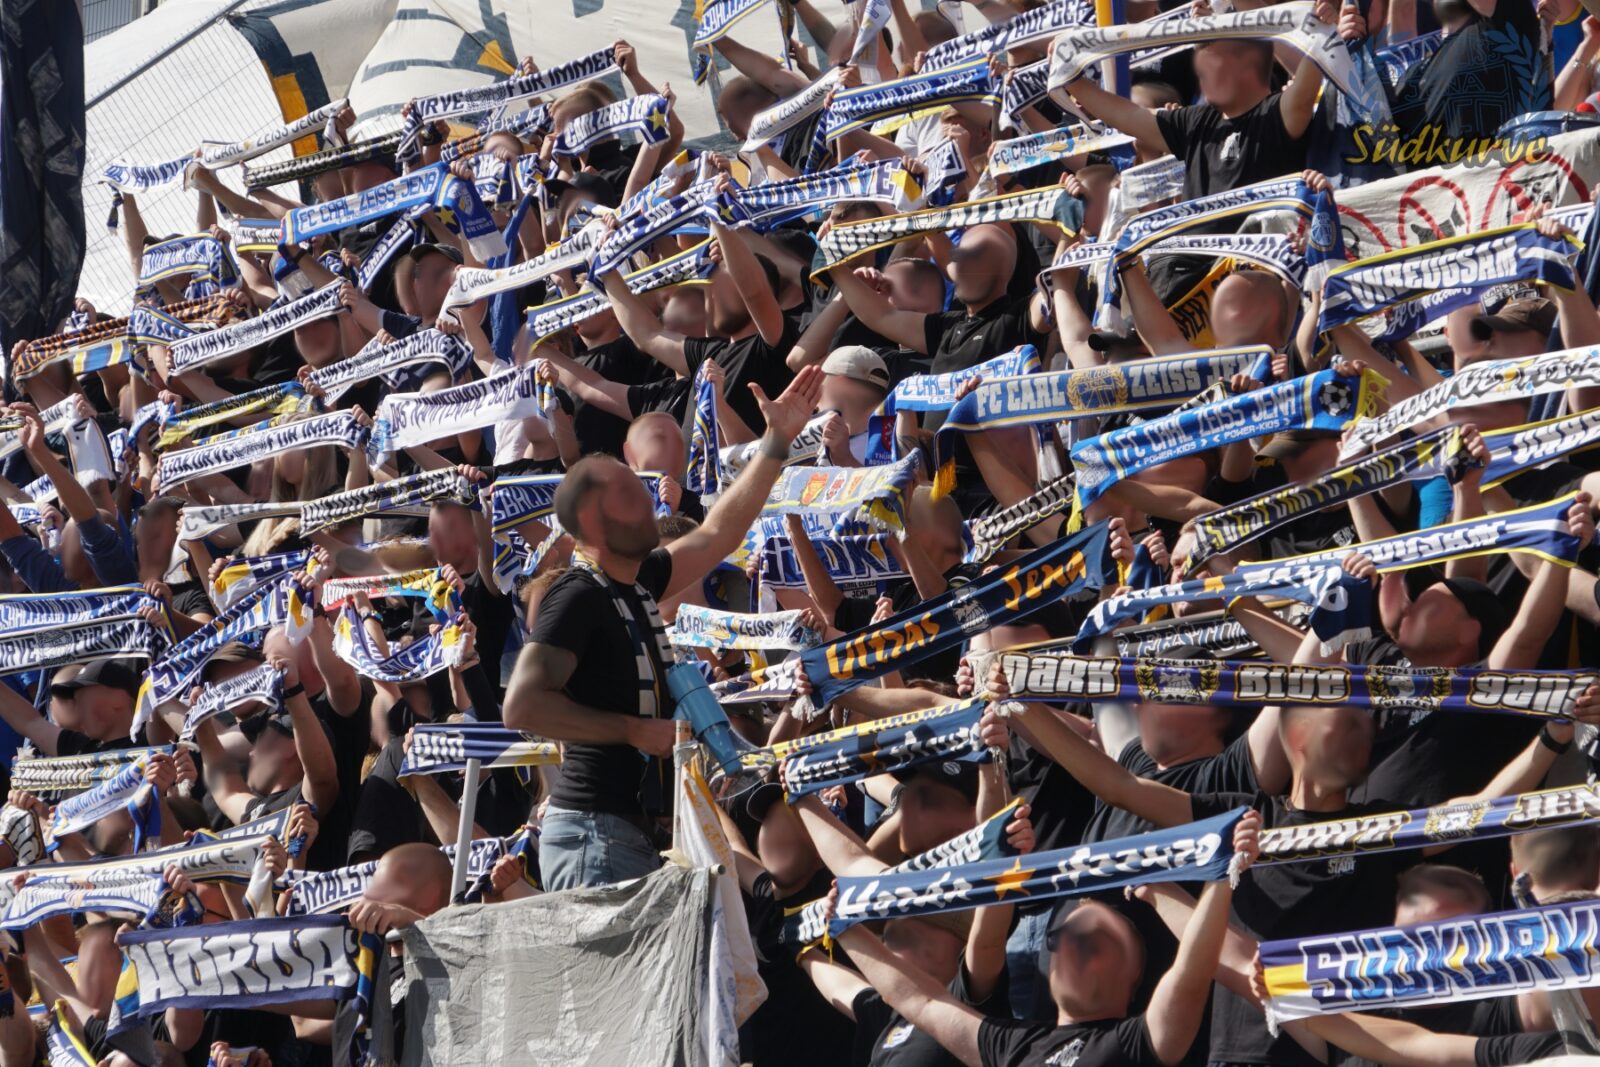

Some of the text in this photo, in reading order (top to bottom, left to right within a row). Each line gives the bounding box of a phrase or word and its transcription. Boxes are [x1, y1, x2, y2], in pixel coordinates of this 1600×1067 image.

[1056, 30, 1110, 63] CARL
[1145, 16, 1217, 39] ZEISS
[1222, 10, 1295, 28] JENA
[550, 47, 617, 87] IMMER
[256, 125, 289, 148] ZEISS
[291, 109, 327, 134] JENA
[597, 102, 628, 131] ZEISS
[994, 150, 1008, 168] FC
[1011, 140, 1041, 162] CARL
[300, 211, 318, 230] FC
[320, 200, 354, 219] CARL
[359, 184, 397, 210] ZEISS
[400, 170, 435, 198] JENA
[508, 256, 546, 277] ZEISS
[549, 232, 592, 261] JENA
[173, 328, 237, 367] ÜDKURVE
[976, 353, 1256, 418] FC CARL ZEISS JEN
[44, 407, 63, 423] ENA
[1115, 384, 1297, 462] FC CARL ZEISS JENA
[792, 424, 825, 450] JEN
[1143, 419, 1281, 464] POWER-KIDS POWER-KIDS
[161, 449, 235, 481] ÜDKURVE
[738, 619, 775, 637] ZEISS
[1302, 904, 1600, 1011] SÜDKURV
